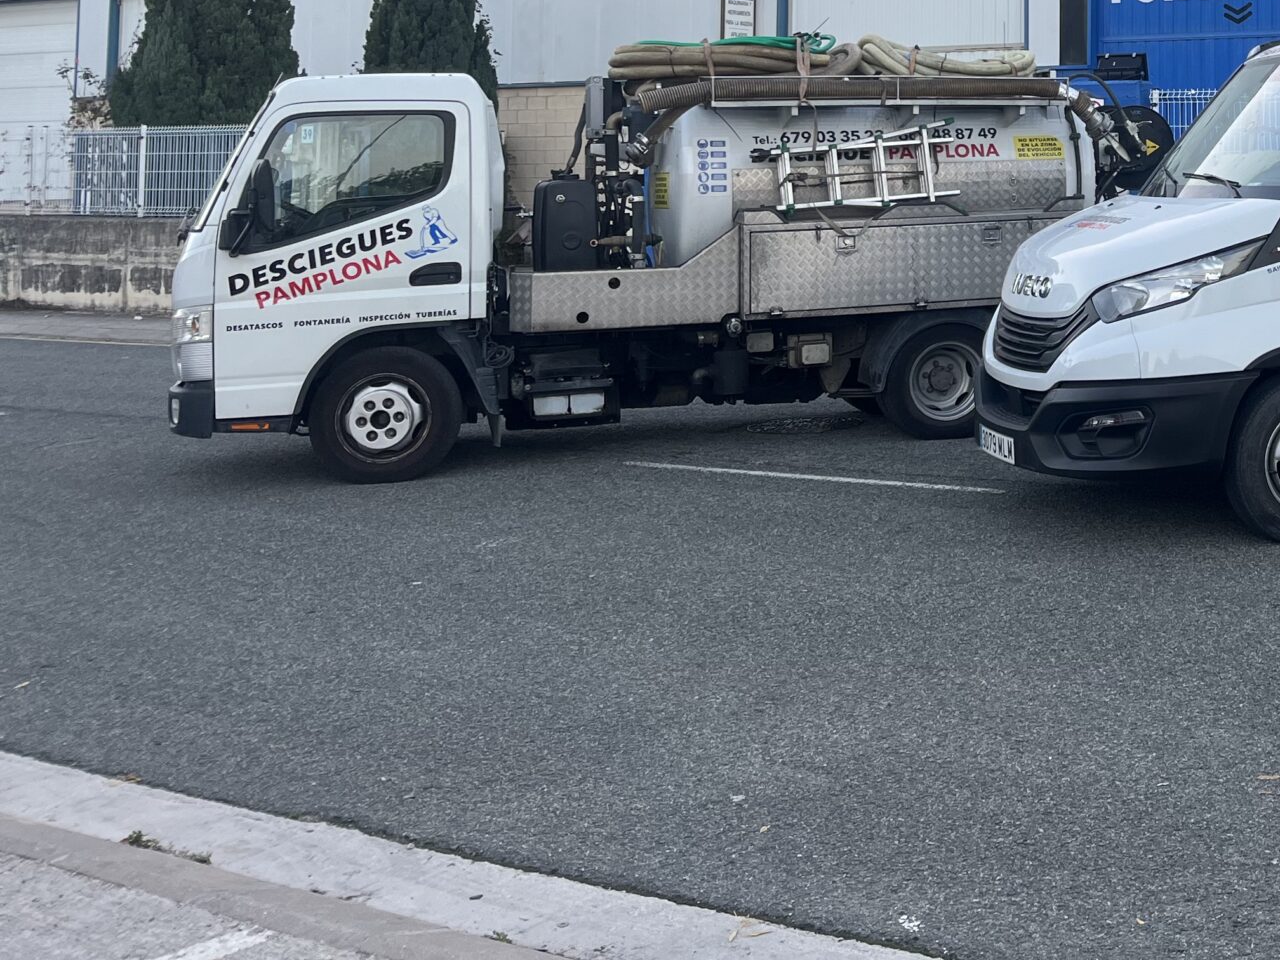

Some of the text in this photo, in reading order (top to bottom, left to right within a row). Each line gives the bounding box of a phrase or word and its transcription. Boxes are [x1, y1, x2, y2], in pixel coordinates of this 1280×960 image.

[752, 135, 777, 145] Tel.:
[780, 130, 811, 144] 679
[816, 130, 837, 143] 03
[840, 130, 861, 142] 35
[955, 127, 974, 140] 87
[977, 126, 997, 139] 49
[888, 144, 1000, 160] PAPLONA
[227, 218, 413, 297] DESCIEGUES
[254, 250, 402, 310] PAMPLONA
[1012, 272, 1052, 299] IVECO
[226, 309, 458, 332] DESATASCOS FONTANERÍA INSPECCIÓN TUBERÍAS
